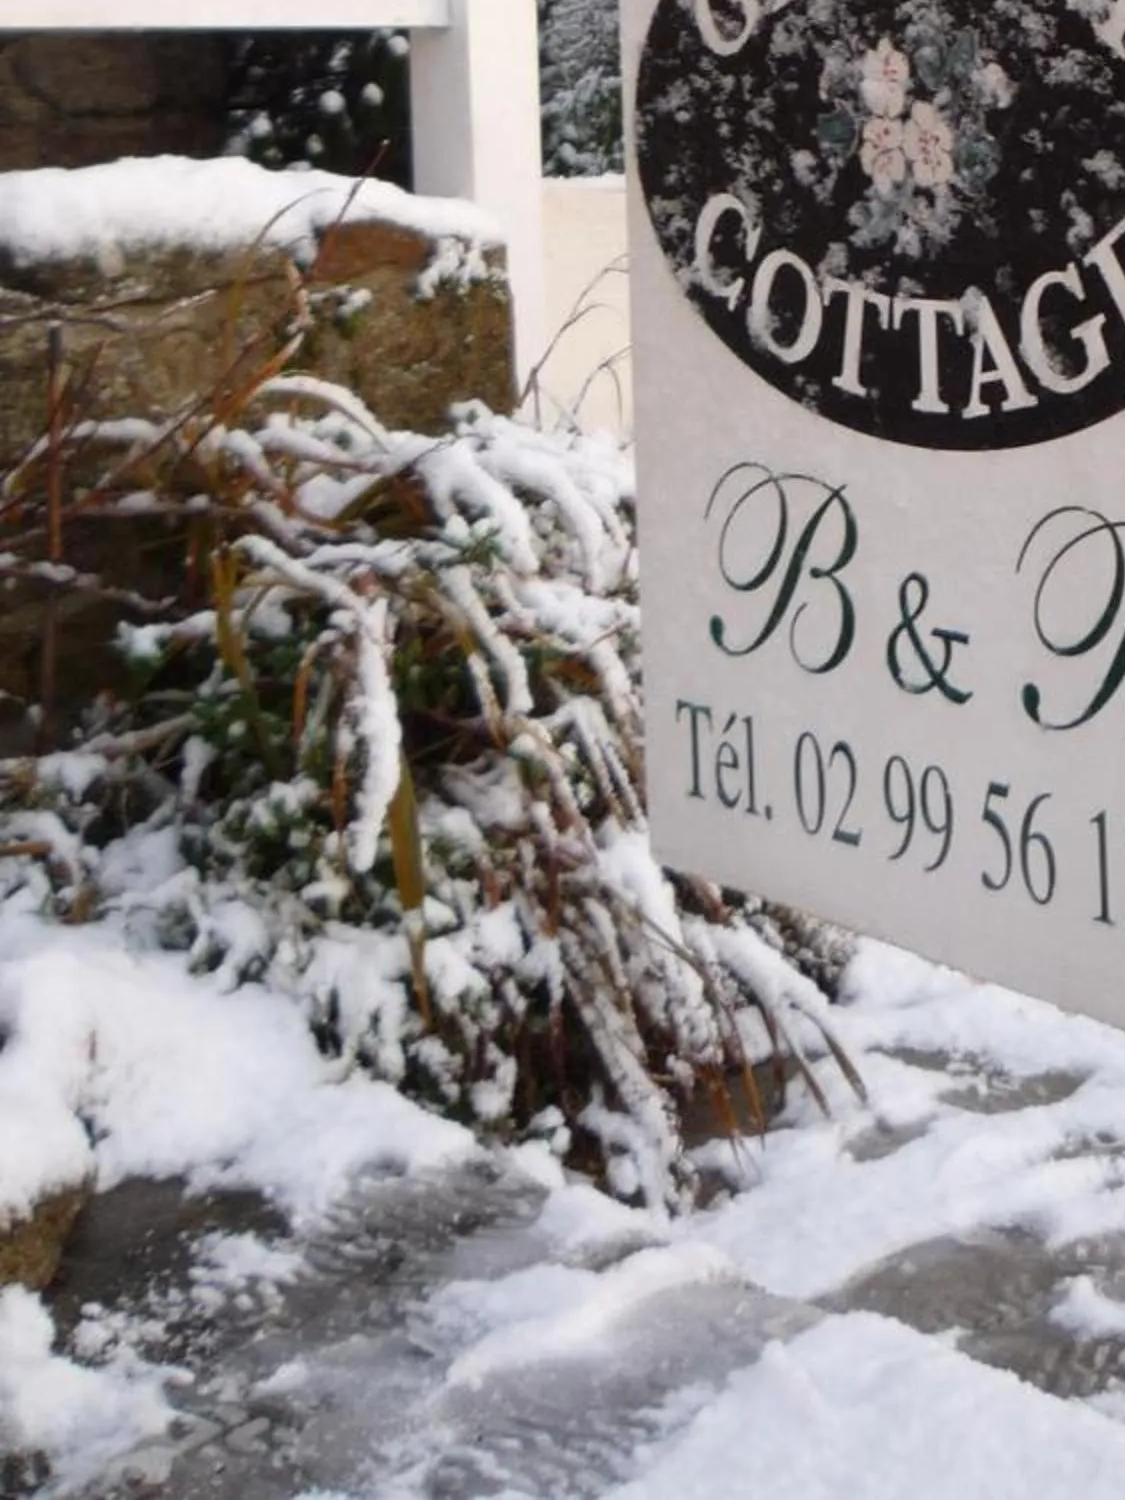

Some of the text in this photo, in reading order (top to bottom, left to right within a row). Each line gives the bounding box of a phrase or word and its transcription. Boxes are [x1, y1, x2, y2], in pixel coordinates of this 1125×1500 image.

[703, 461, 859, 674] B
[886, 571, 974, 704] &
[675, 699, 773, 821] Tél.
[793, 731, 862, 848] 02
[883, 755, 955, 873] 99
[980, 781, 1057, 906] 56
